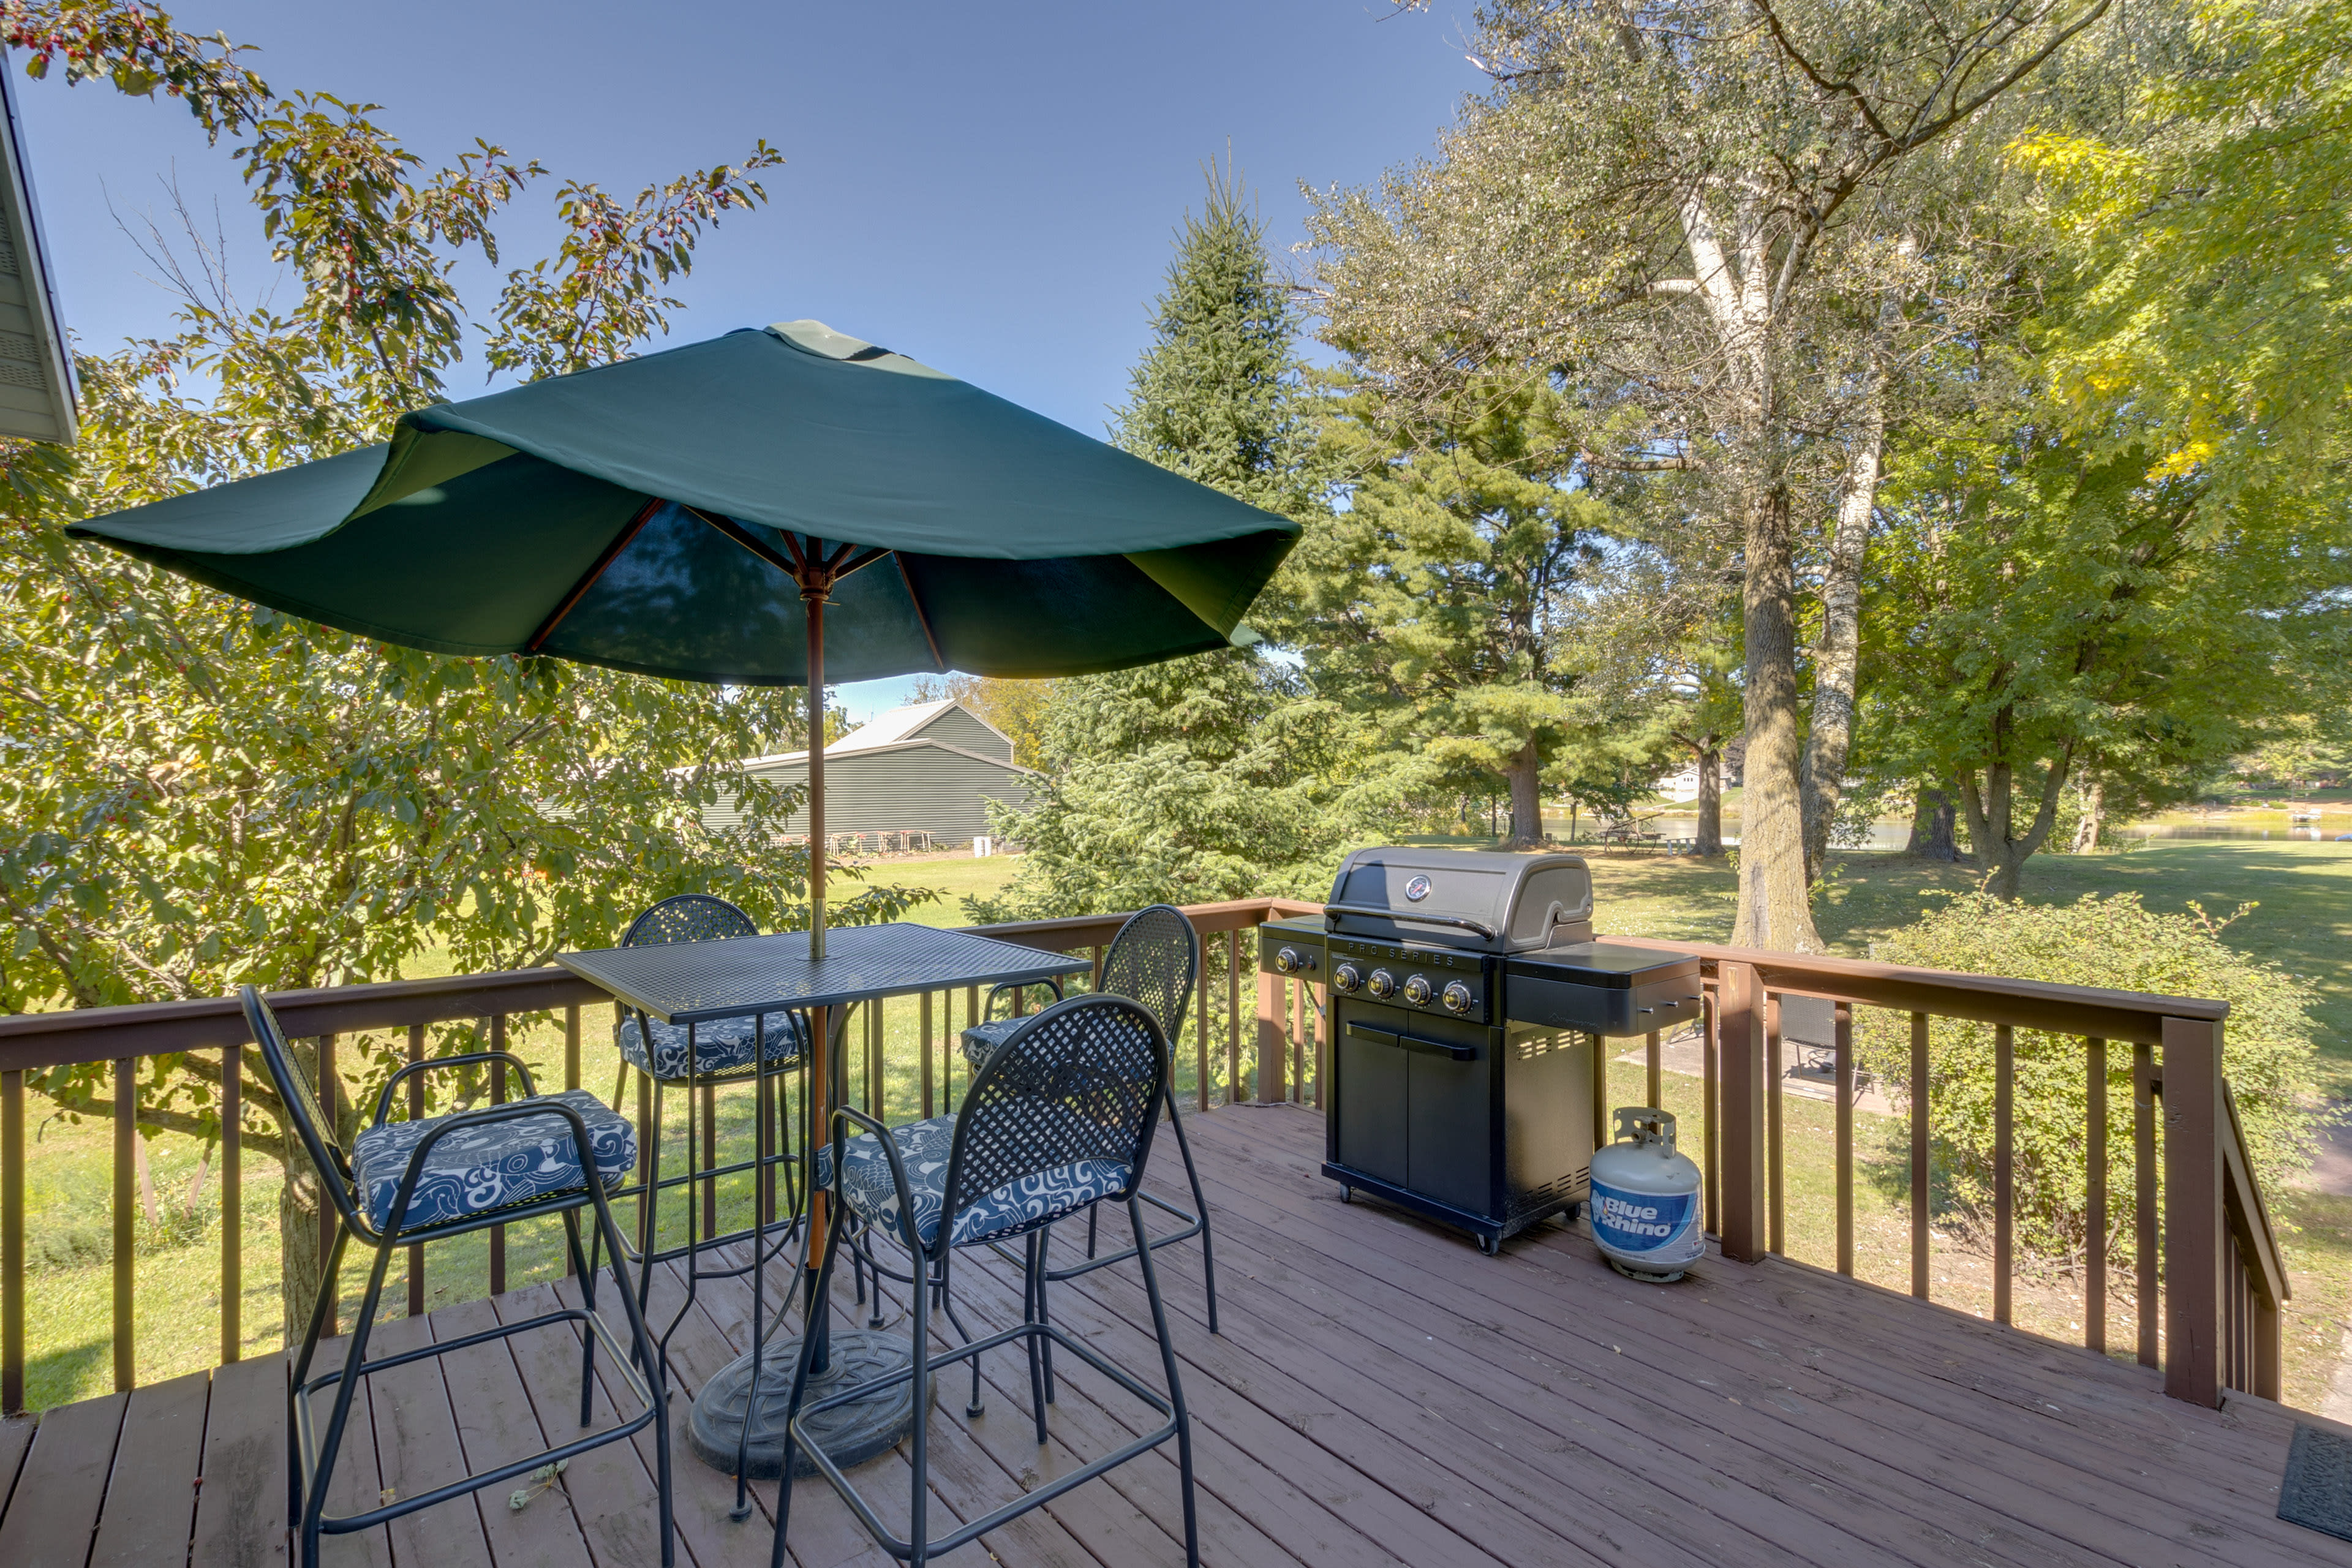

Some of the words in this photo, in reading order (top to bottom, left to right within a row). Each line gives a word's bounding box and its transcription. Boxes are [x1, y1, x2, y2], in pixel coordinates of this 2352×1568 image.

[1349, 942, 1378, 956] PRO
[1389, 948, 1454, 966] SERIES
[1605, 1196, 1658, 1220] Blue
[1602, 1213, 1671, 1237] Rhino
